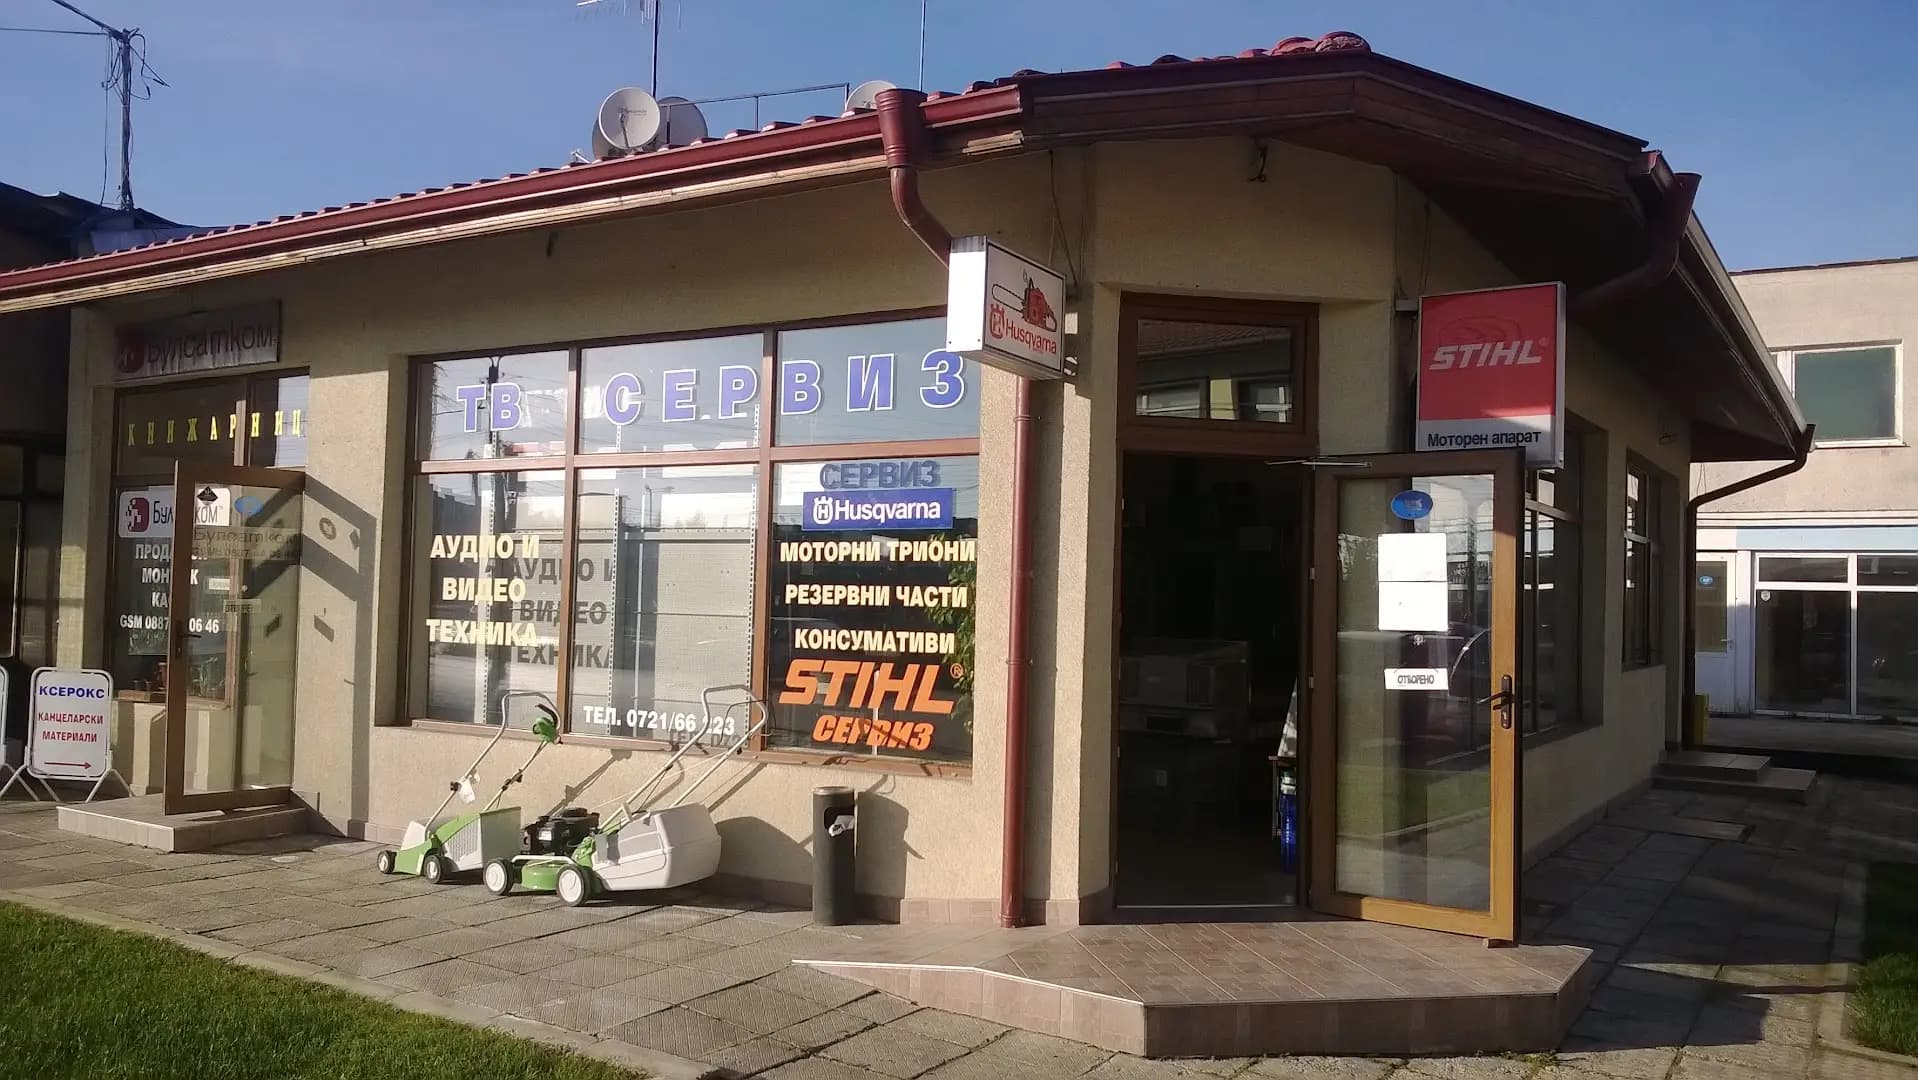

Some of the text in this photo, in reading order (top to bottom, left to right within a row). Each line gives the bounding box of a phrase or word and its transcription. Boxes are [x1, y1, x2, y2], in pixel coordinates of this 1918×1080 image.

[1006, 318, 1056, 355] Husqvarna
[457, 348, 965, 433] ТВ СЕРВИЗ
[1428, 431, 1541, 448] Моторен апарат
[820, 460, 941, 490] СЕРВИЗ
[834, 499, 941, 523] Husqvarna
[430, 535, 540, 563] АУДИО И
[780, 540, 976, 562] МОТОРНИ ТРИОНИ
[442, 577, 526, 605] ВИДЕО
[785, 584, 968, 608] РЕЗЕРВНИ ЧАСТИ
[119, 615, 142, 629] GSM
[189, 619, 202, 632] 06
[205, 620, 219, 633] 46
[426, 619, 538, 647] ТЕХНИКА
[795, 628, 955, 654] КОНСУМАТИВИ
[39, 685, 105, 699] КСЕРОКС
[38, 711, 104, 725] КАНЦЕЛАРСКИ
[583, 705, 621, 726] ТЕЛ.
[626, 709, 697, 732] 0721/66
[42, 730, 97, 743] МАТЕРИАЛИ
[812, 714, 934, 751] СЕРВИЗ
